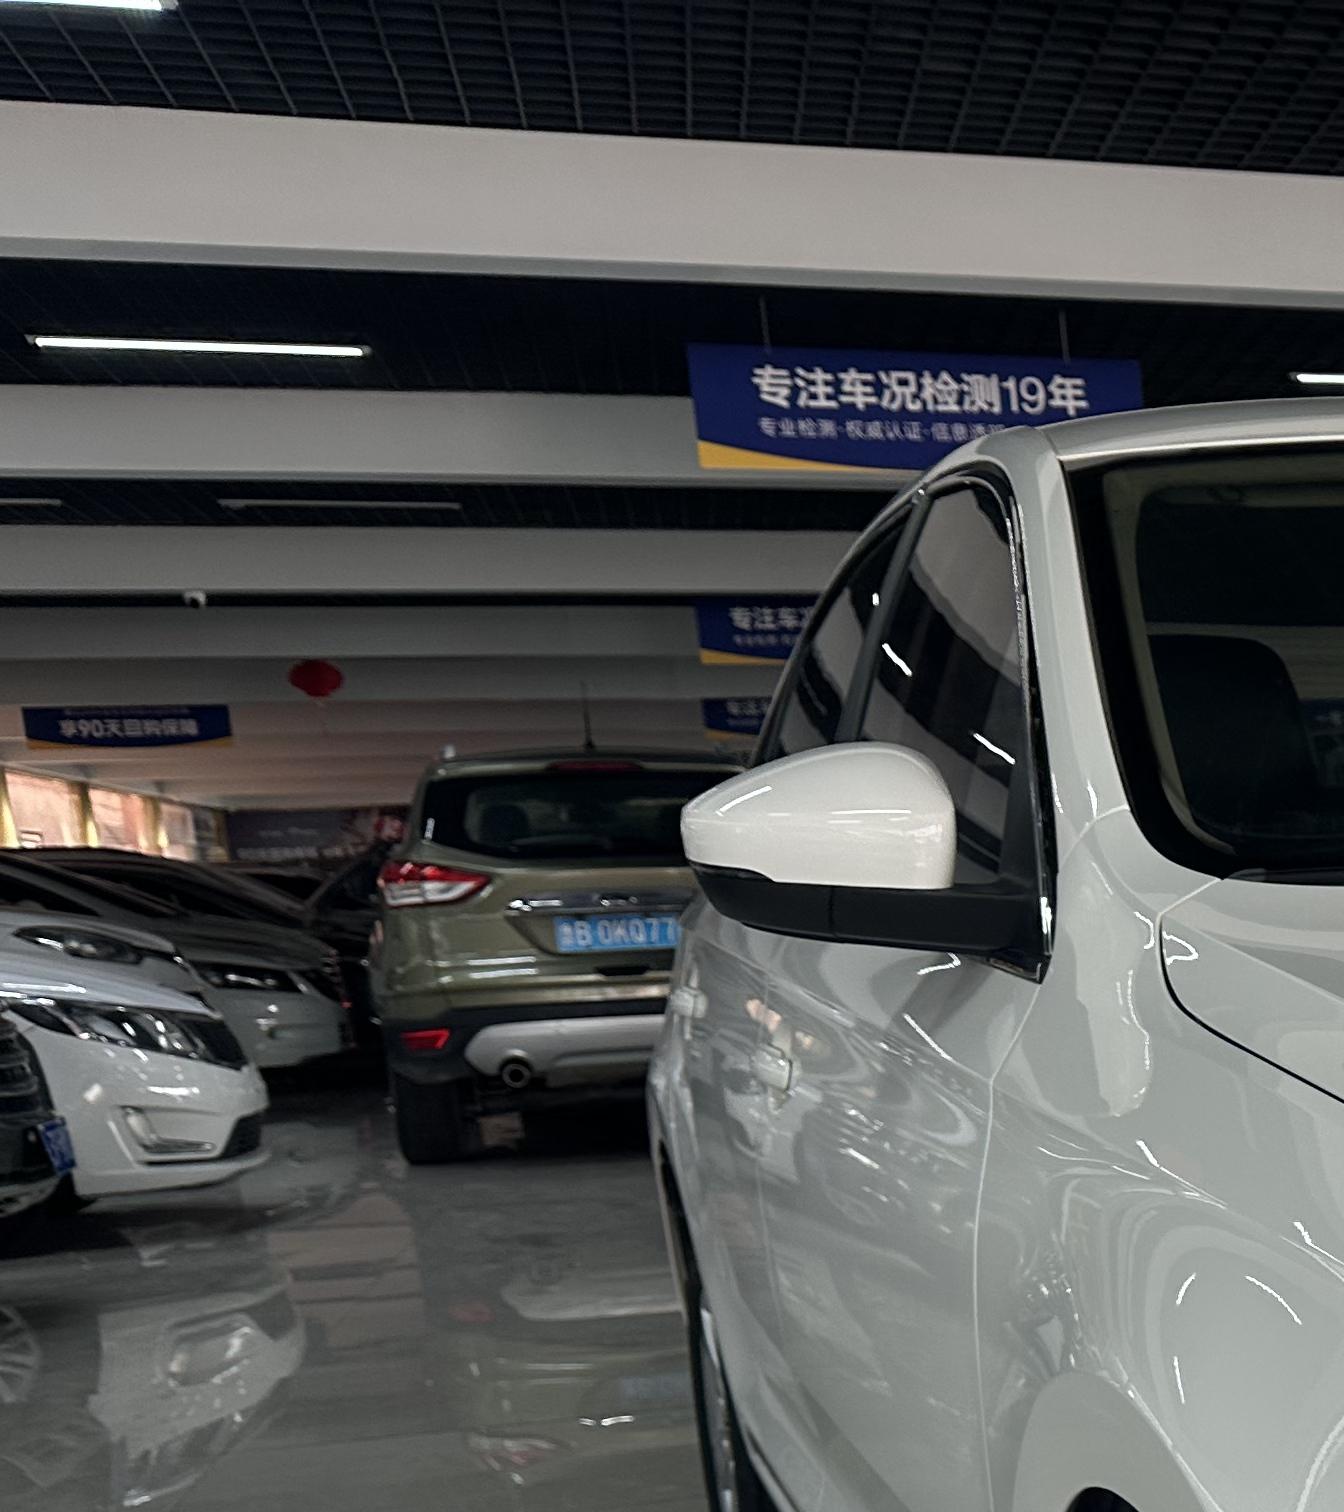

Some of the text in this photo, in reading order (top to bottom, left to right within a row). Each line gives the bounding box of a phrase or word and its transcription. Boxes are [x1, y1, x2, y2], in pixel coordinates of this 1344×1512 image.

[751, 364, 1089, 416] 专注车况检测19年
